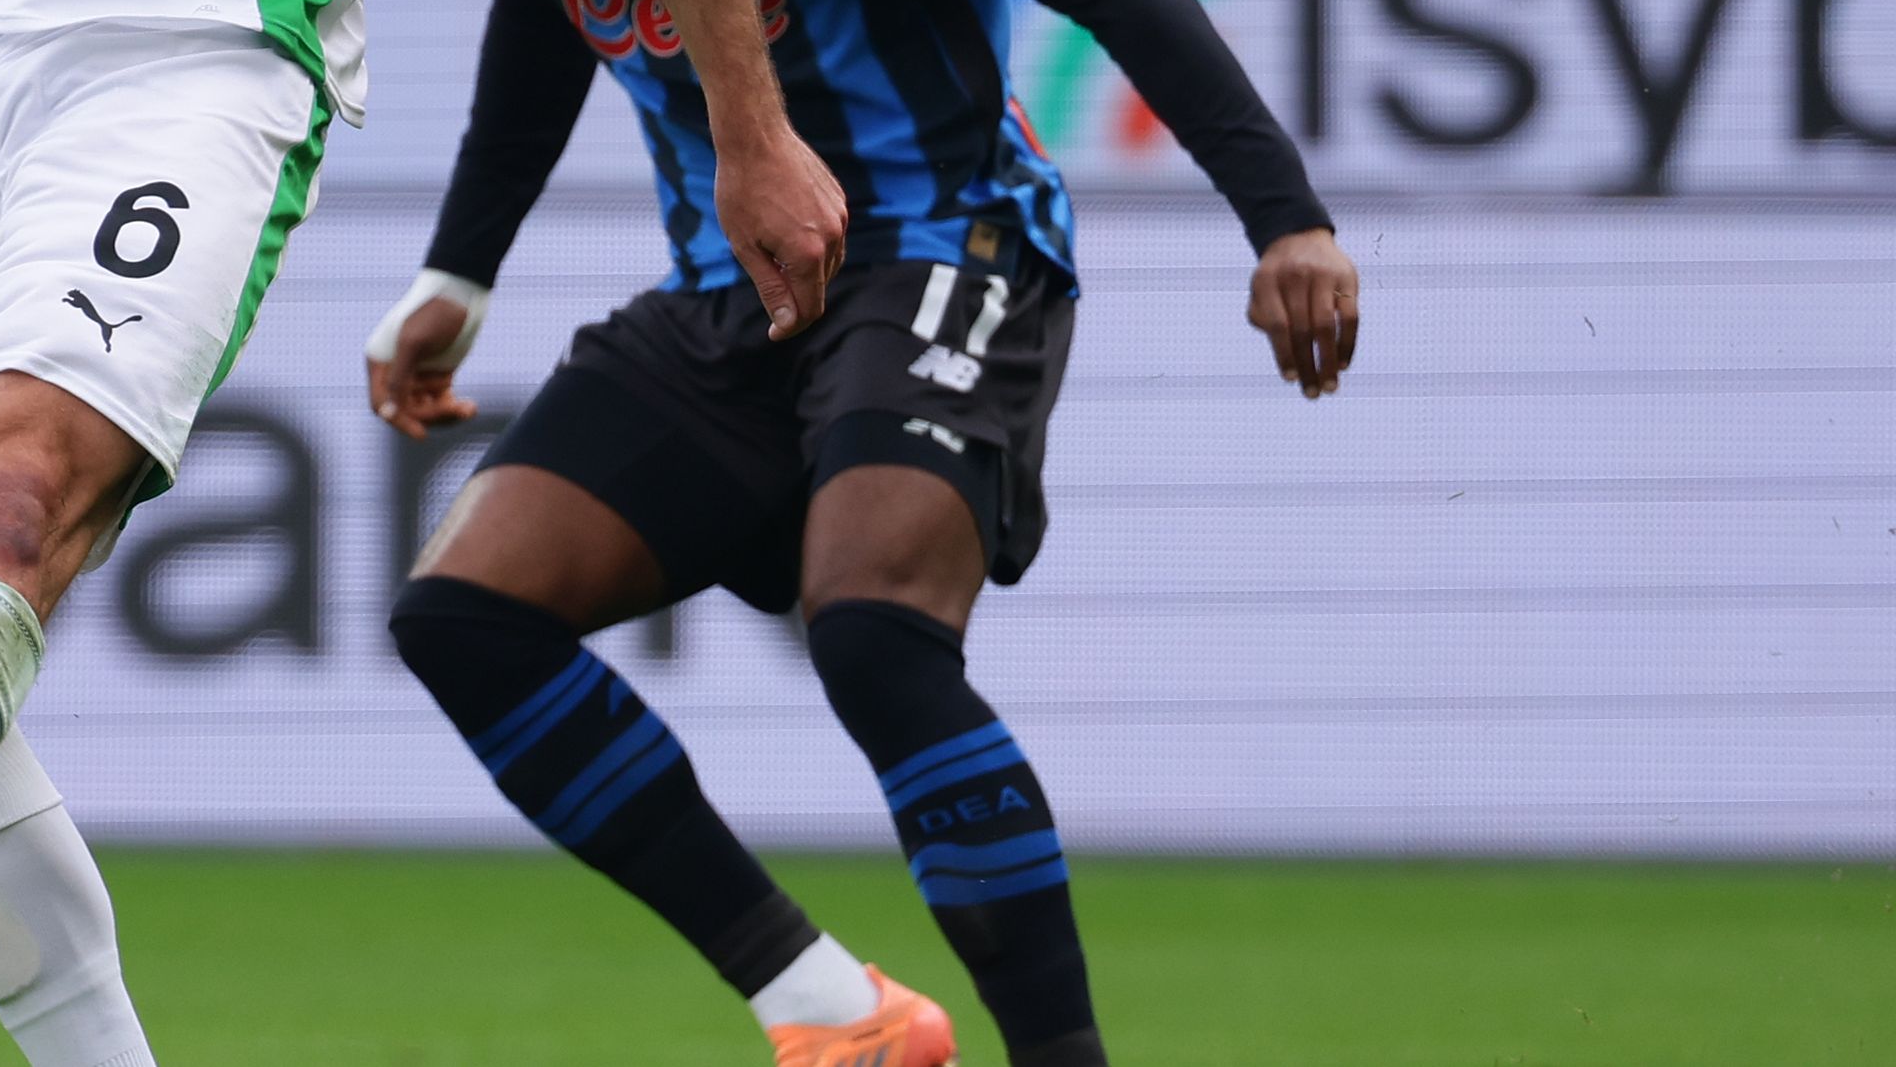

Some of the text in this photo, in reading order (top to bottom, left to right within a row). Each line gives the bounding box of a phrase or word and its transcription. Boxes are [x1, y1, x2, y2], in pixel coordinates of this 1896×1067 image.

[93, 181, 190, 279] 6
[907, 343, 983, 394] NB
[916, 785, 1031, 834] DEA
